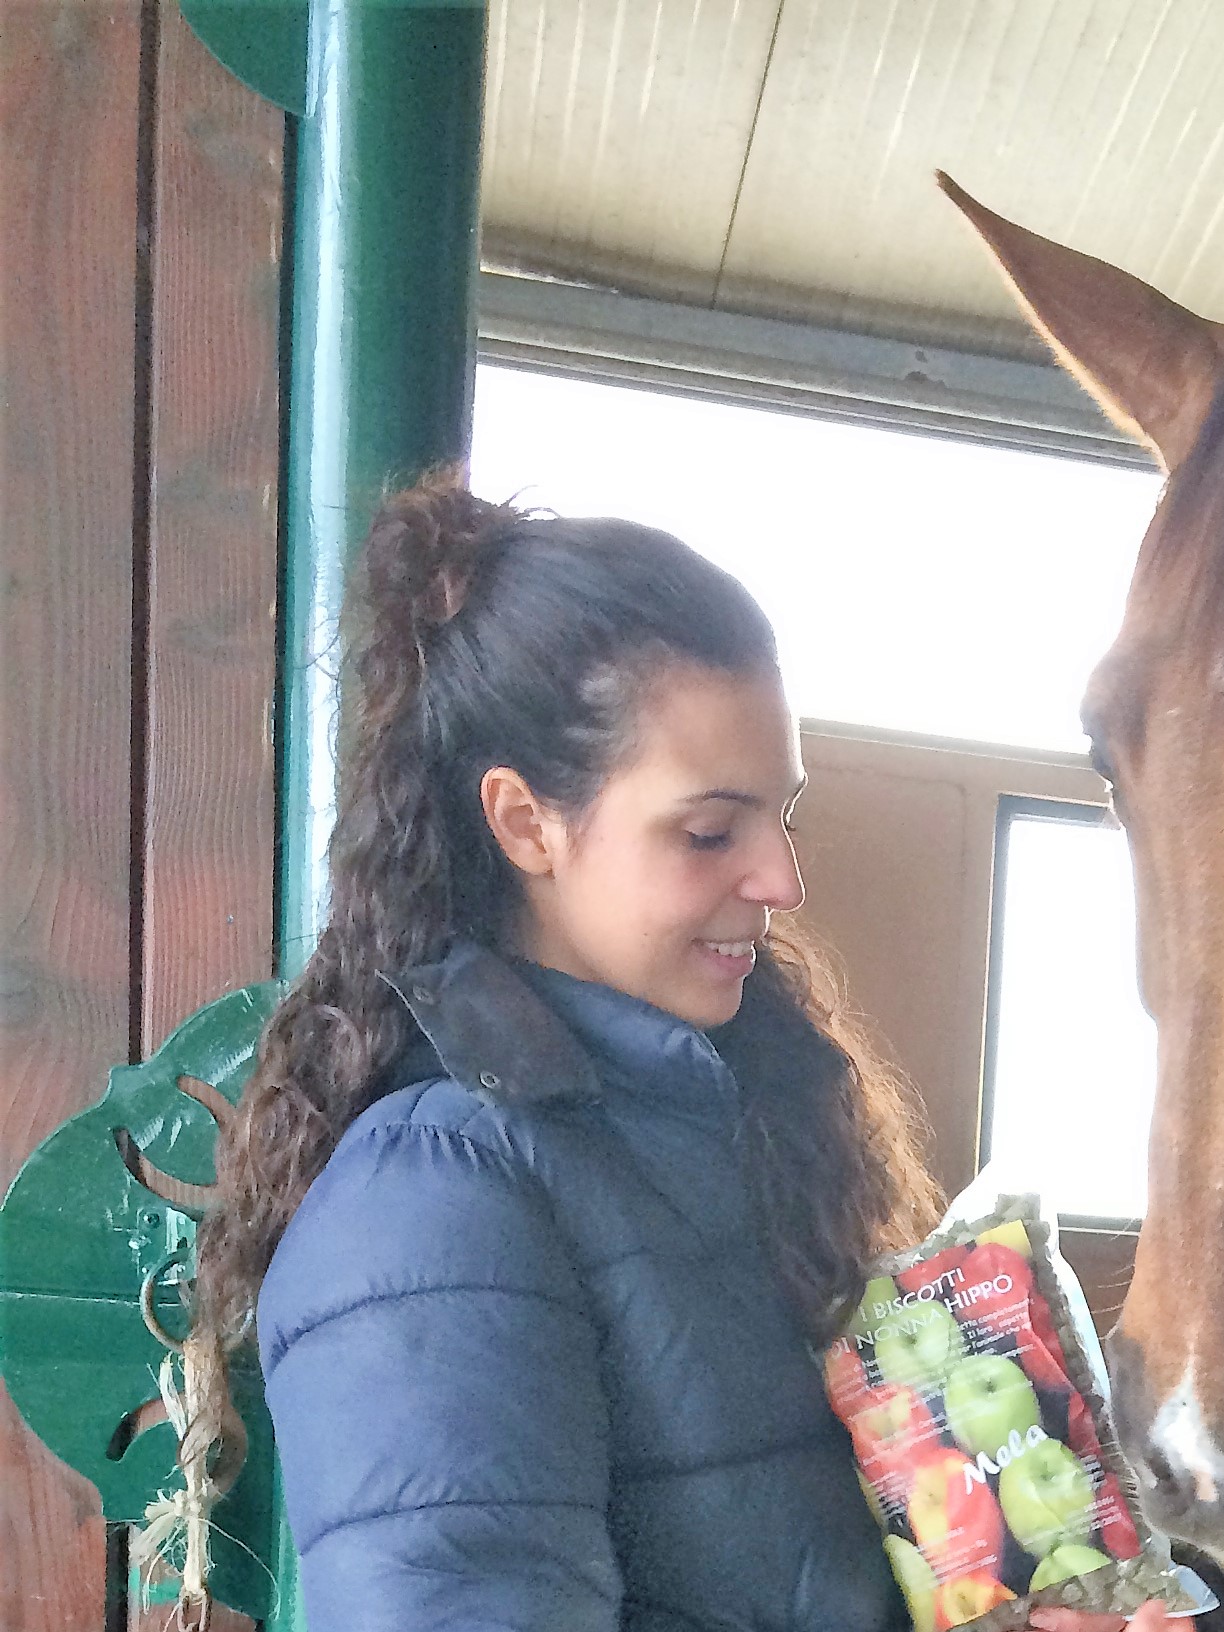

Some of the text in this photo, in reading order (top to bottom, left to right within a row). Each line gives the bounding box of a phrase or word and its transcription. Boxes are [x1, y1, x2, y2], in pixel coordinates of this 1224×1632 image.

[854, 1308, 943, 1350] NONNA
[943, 1274, 1013, 1313] HIPPO
[872, 1267, 966, 1320] BISCOTTI
